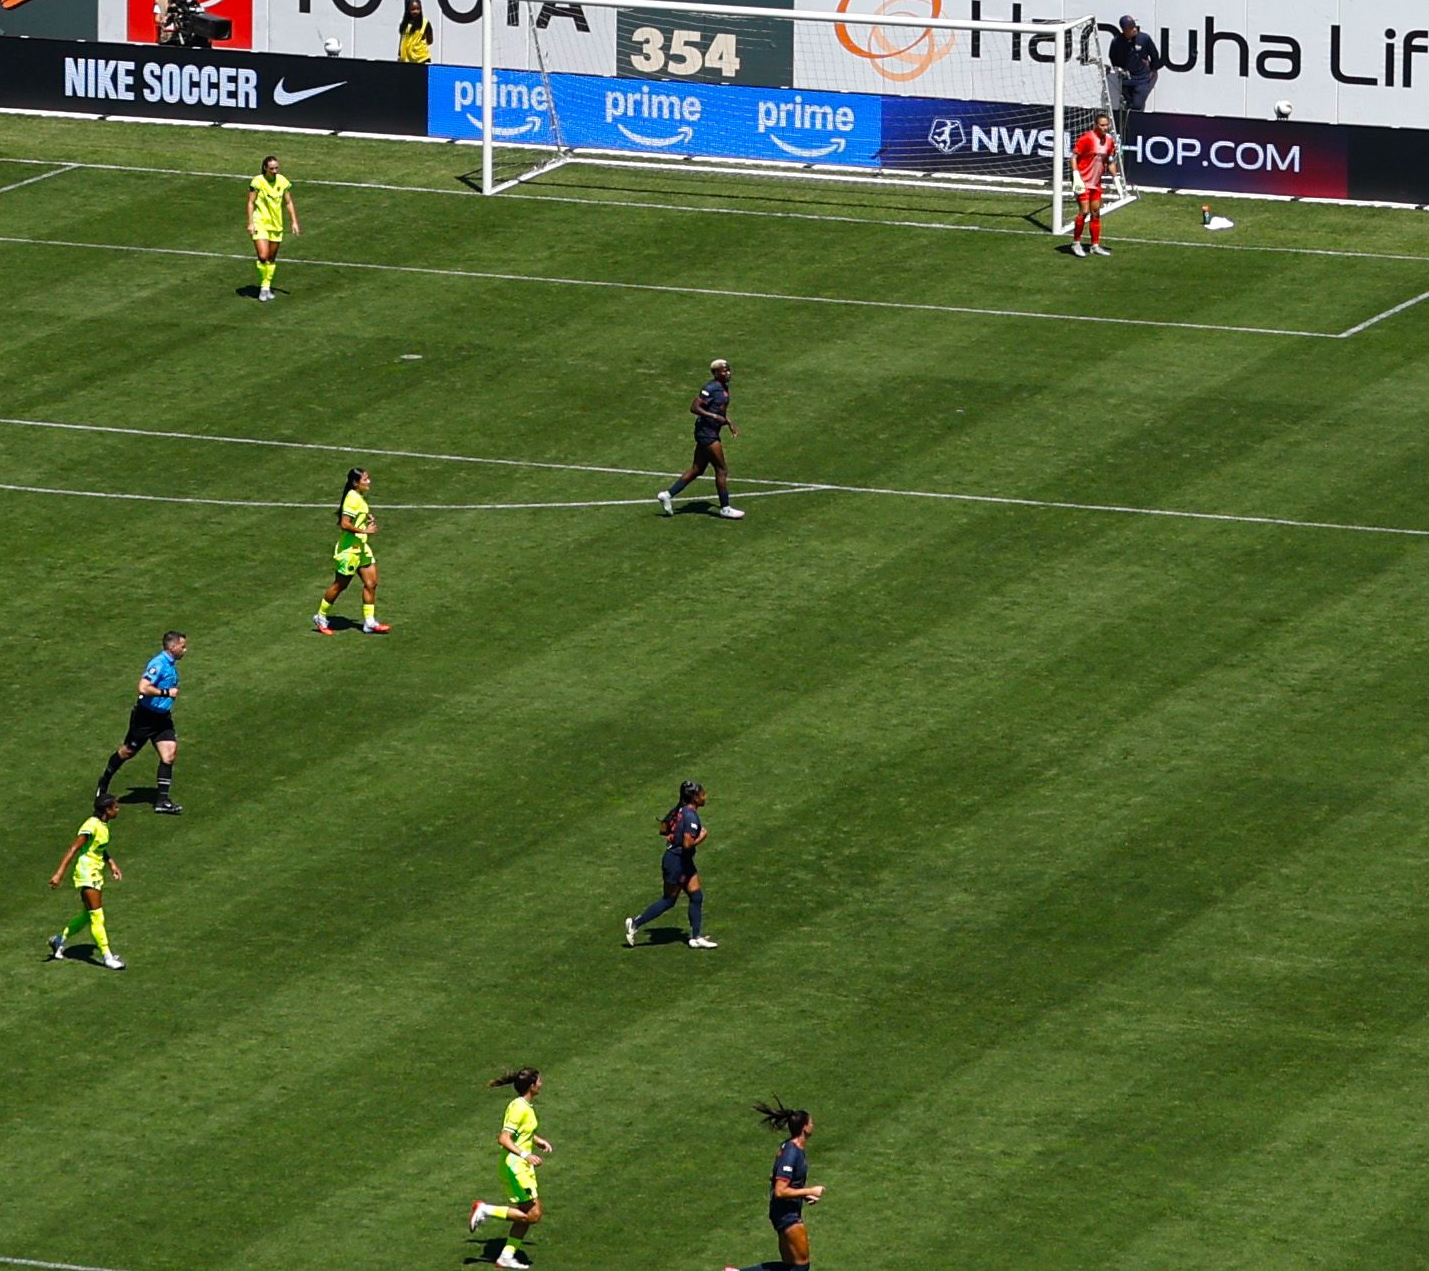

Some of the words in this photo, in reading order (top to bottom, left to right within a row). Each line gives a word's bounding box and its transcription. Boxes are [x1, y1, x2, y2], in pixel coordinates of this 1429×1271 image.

[630, 26, 741, 78] 354
[63, 57, 135, 102] NIKE
[142, 61, 258, 111] SOCCER
[604, 85, 702, 124] prime
[757, 95, 856, 134] prime
